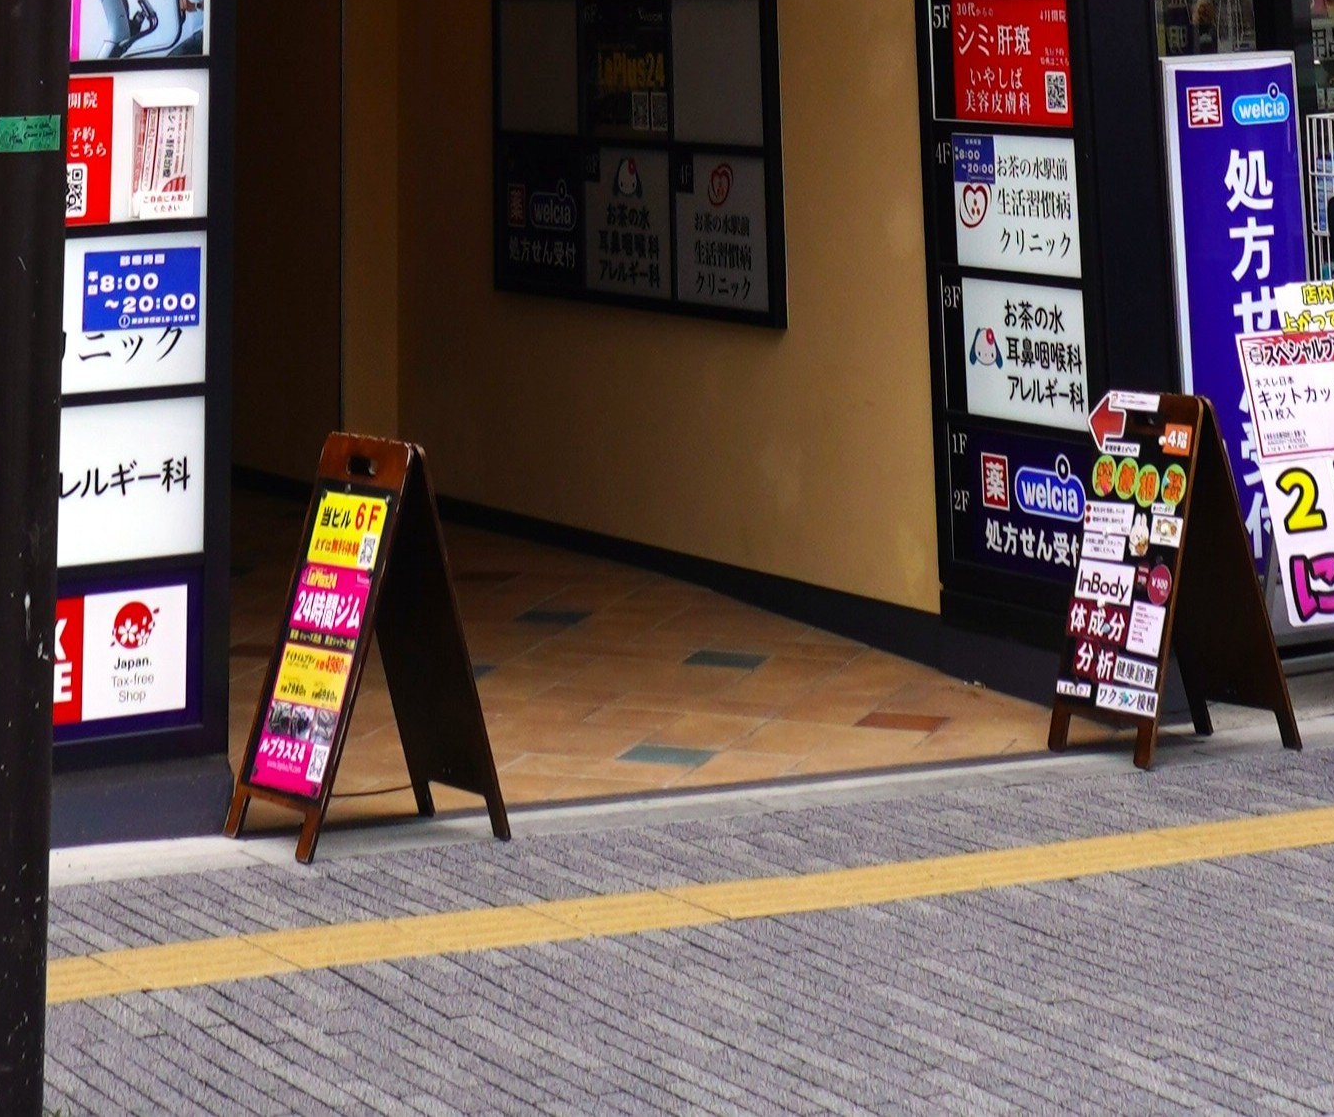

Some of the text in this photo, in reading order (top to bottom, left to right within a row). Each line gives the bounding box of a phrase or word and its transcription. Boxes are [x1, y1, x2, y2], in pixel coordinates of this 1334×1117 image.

[932, 3, 951, 29] 5F
[969, 65, 1024, 90] いやしば
[965, 88, 1032, 116] 美容皮膚科
[1190, 90, 1220, 124] 薬
[1238, 100, 1285, 120] welcia
[996, 154, 1068, 182] お茶の水駅前
[532, 195, 572, 227] welcia
[997, 187, 1072, 221] 生活習慣病
[999, 227, 1072, 259] クリニック
[99, 272, 159, 293] 8:00
[943, 285, 961, 309] 3F
[1003, 299, 1065, 334] お茶の水
[1005, 336, 1083, 374] 耳鼻咽喉科
[1007, 375, 1085, 414] アレルギー科
[1254, 375, 1295, 388] ネスレ日本
[1167, 429, 1188, 450] 4階
[985, 460, 1006, 503] 薬
[1020, 469, 1080, 515] welcia
[320, 505, 352, 529] 当ビル
[1078, 569, 1130, 603] InBody
[293, 589, 361, 631] 24時間ジム
[1069, 602, 1126, 643] 体成分
[1075, 641, 1114, 681] 分析
[1116, 659, 1156, 686] 健康診断
[111, 673, 155, 688] Tax-free
[117, 689, 147, 704] Shop
